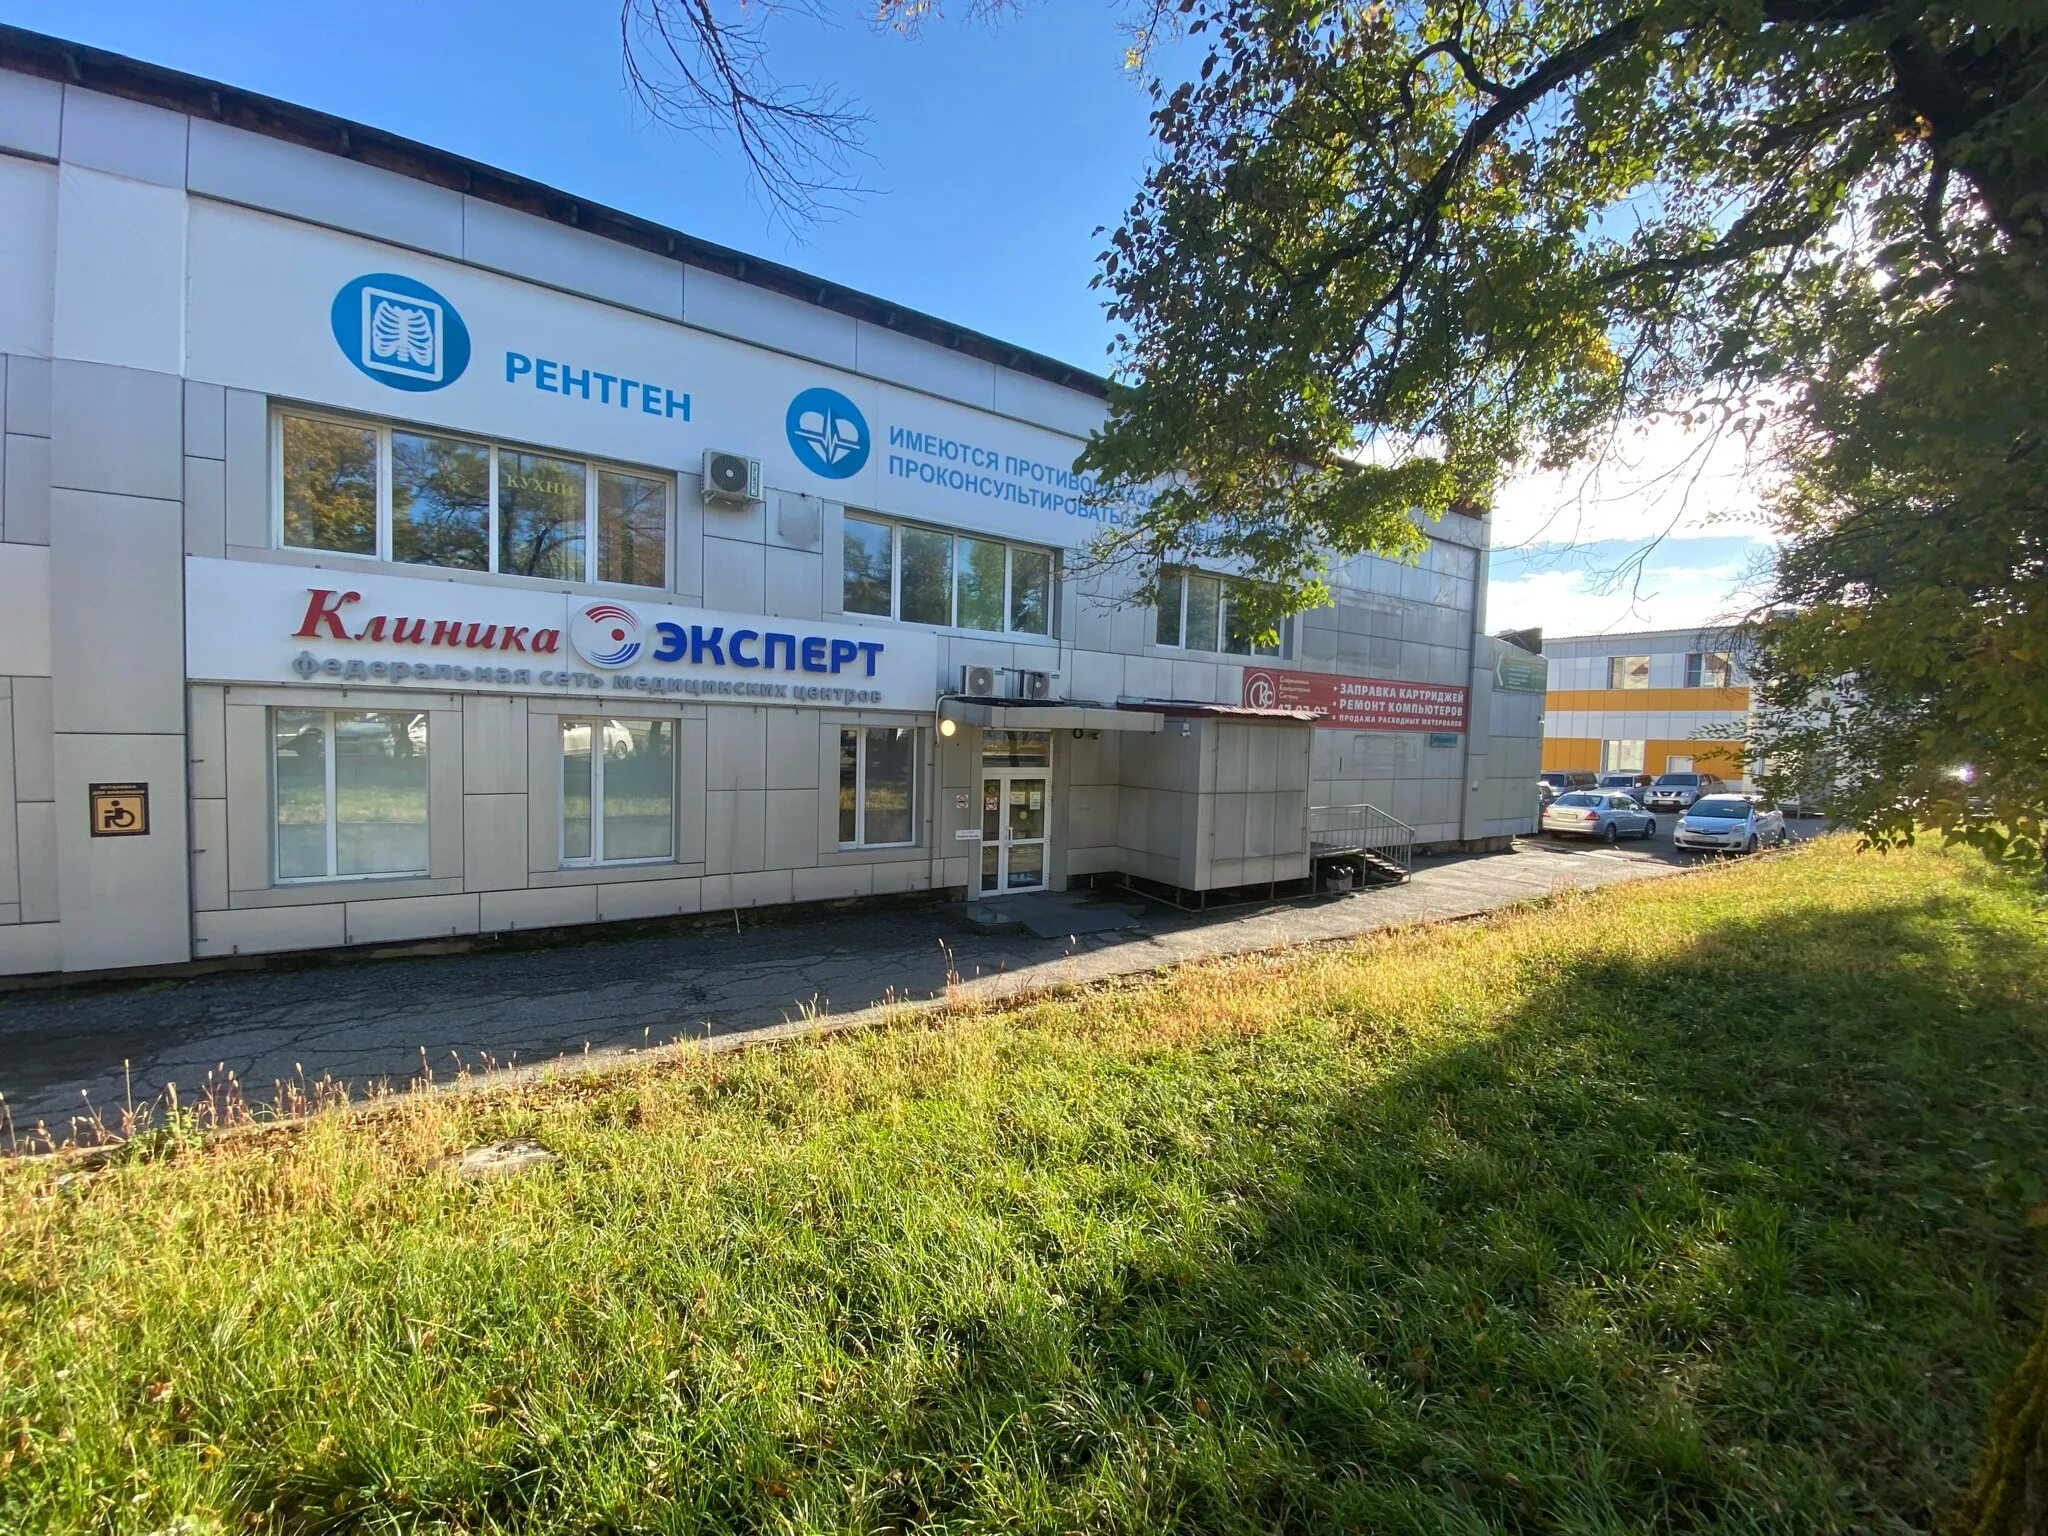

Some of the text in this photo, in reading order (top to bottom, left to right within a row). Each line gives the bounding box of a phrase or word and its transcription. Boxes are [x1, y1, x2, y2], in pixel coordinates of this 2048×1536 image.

[506, 352, 691, 422] РЕНТГЕН
[890, 425, 999, 471] ИМЕЮТСЯ
[505, 474, 574, 497] КУХНИ
[291, 588, 885, 677] Клиника ЭКСПЕРТ
[292, 650, 883, 706] федеральная сеть медицинских центров
[1340, 683, 1464, 703] ЗАПРАВКА КАРТРИДЖЕЙ
[1339, 699, 1463, 717] РЕМОНТ КОМПЬЮТЕРОВ
[1339, 714, 1462, 727] ПРОДАЖА РАСХОДНЫХ МАТЕРИАЛОВ
